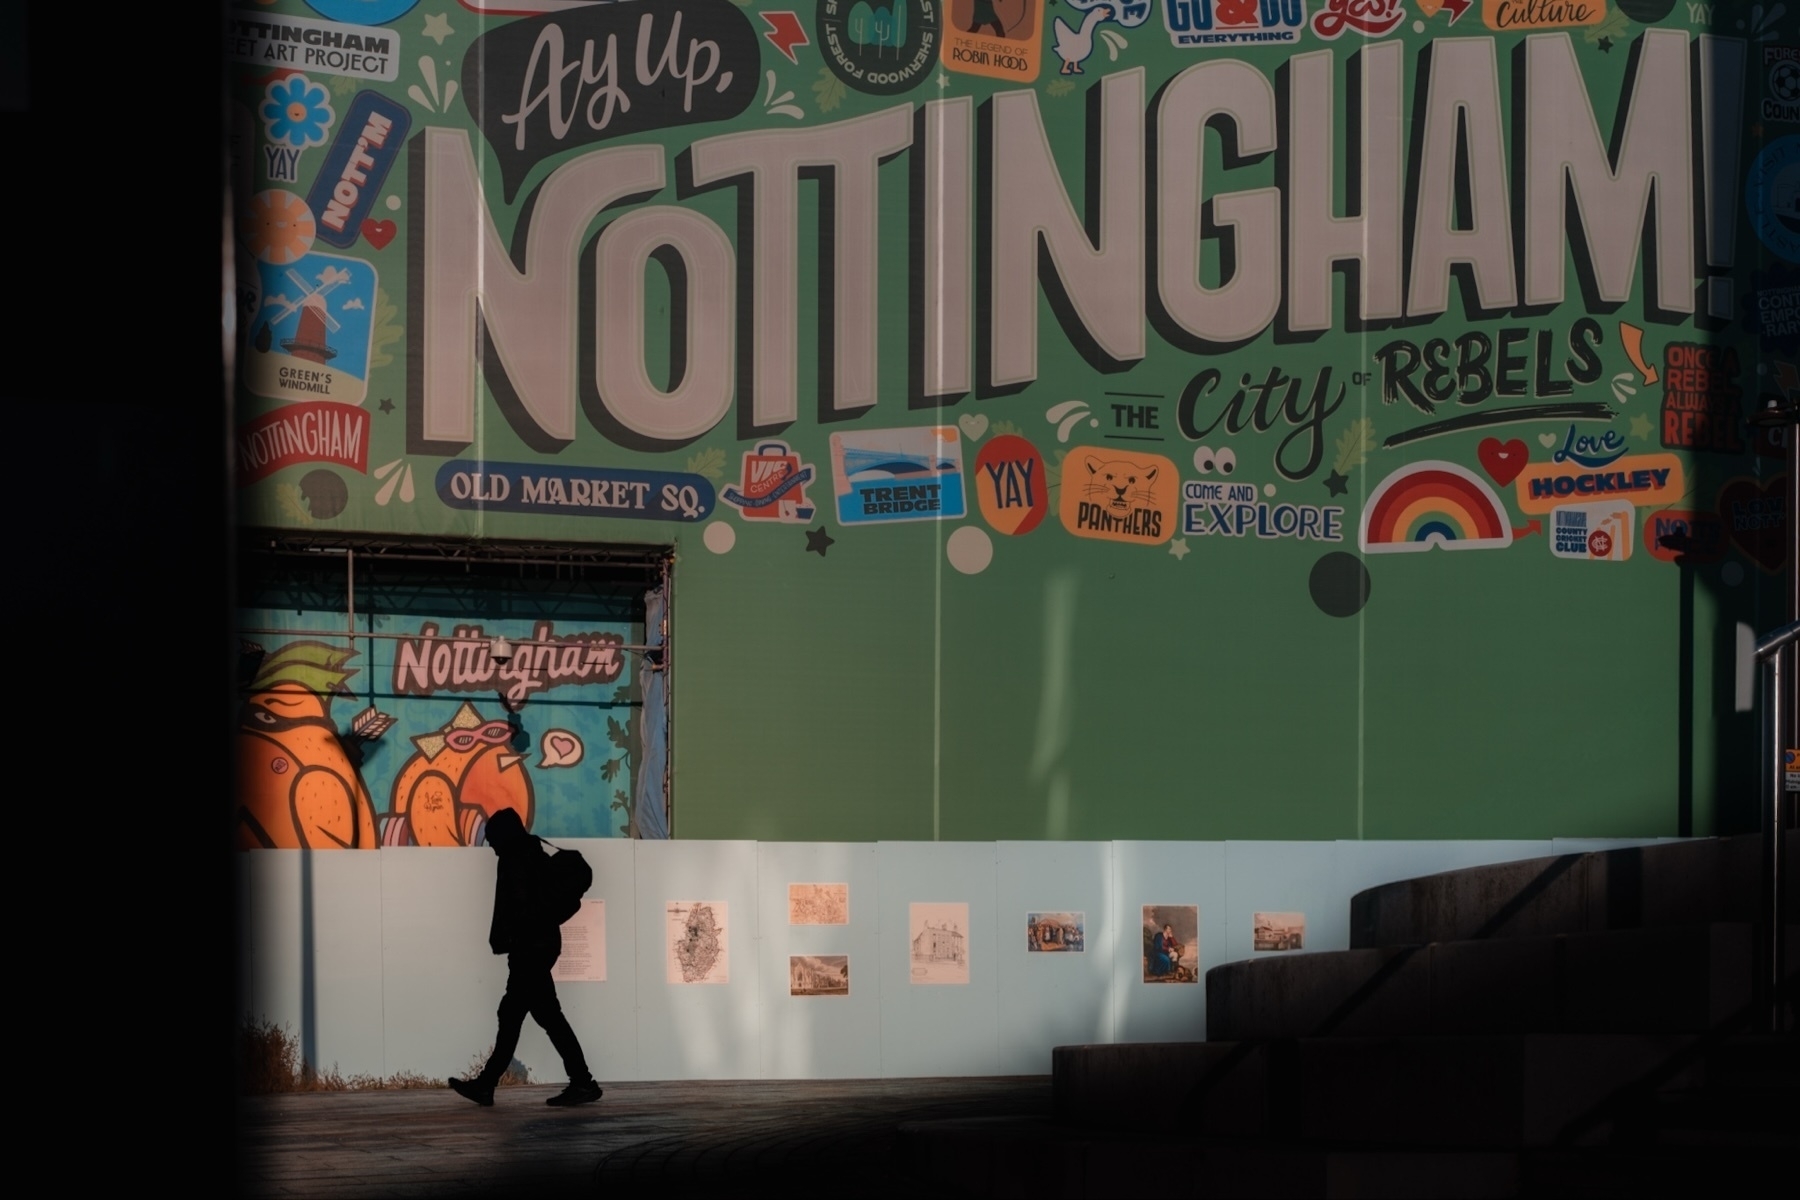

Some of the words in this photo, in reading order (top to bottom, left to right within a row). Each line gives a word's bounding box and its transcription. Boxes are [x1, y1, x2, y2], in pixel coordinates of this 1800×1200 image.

[1496, 0, 1597, 28] Culture
[1686, 1, 1715, 26] YAY
[230, 19, 390, 54] TTINGHAM
[825, 23, 864, 80] FOREST
[954, 37, 972, 48] THE
[973, 40, 1012, 55] LEGEND
[1014, 46, 1028, 56] OF
[1178, 31, 1294, 44] EVERYTHING
[264, 43, 298, 62] ART
[305, 48, 389, 74] PROJECT
[866, 31, 934, 84] SHERWOOD
[953, 47, 989, 65] ROBIN
[994, 54, 1028, 71] HOOD
[501, 22, 631, 151] Ay
[635, 11, 734, 113] Up,
[266, 146, 299, 180] YAY
[321, 110, 393, 233] NOTT'M
[408, 27, 1750, 445] NOTTINGHAM!
[279, 366, 332, 384] GREEN'S
[1374, 317, 1604, 416] REBELS
[279, 377, 331, 394] WINDMILL
[1111, 404, 1159, 429] THE
[1177, 366, 1347, 481] City
[1352, 371, 1372, 386] OF
[238, 409, 363, 471] NOTTINGHAM
[1553, 424, 1629, 468] Love
[450, 471, 510, 501] OLD
[521, 474, 649, 510] MARKET
[661, 484, 706, 518] SQ.
[750, 469, 785, 493] CENTRE
[859, 484, 941, 502] TRENT
[985, 458, 1034, 509] YAY
[1185, 483, 1224, 501] COME
[1228, 485, 1254, 502] AND
[1528, 468, 1670, 500] HOCKLEY
[863, 498, 941, 515] BRIDGE
[1077, 501, 1162, 537] PANTHERS
[1184, 503, 1344, 540] EXPLORE
[1556, 527, 1587, 535] COUNTY
[1556, 535, 1587, 543] CRICKET
[1556, 542, 1587, 553] CLUB
